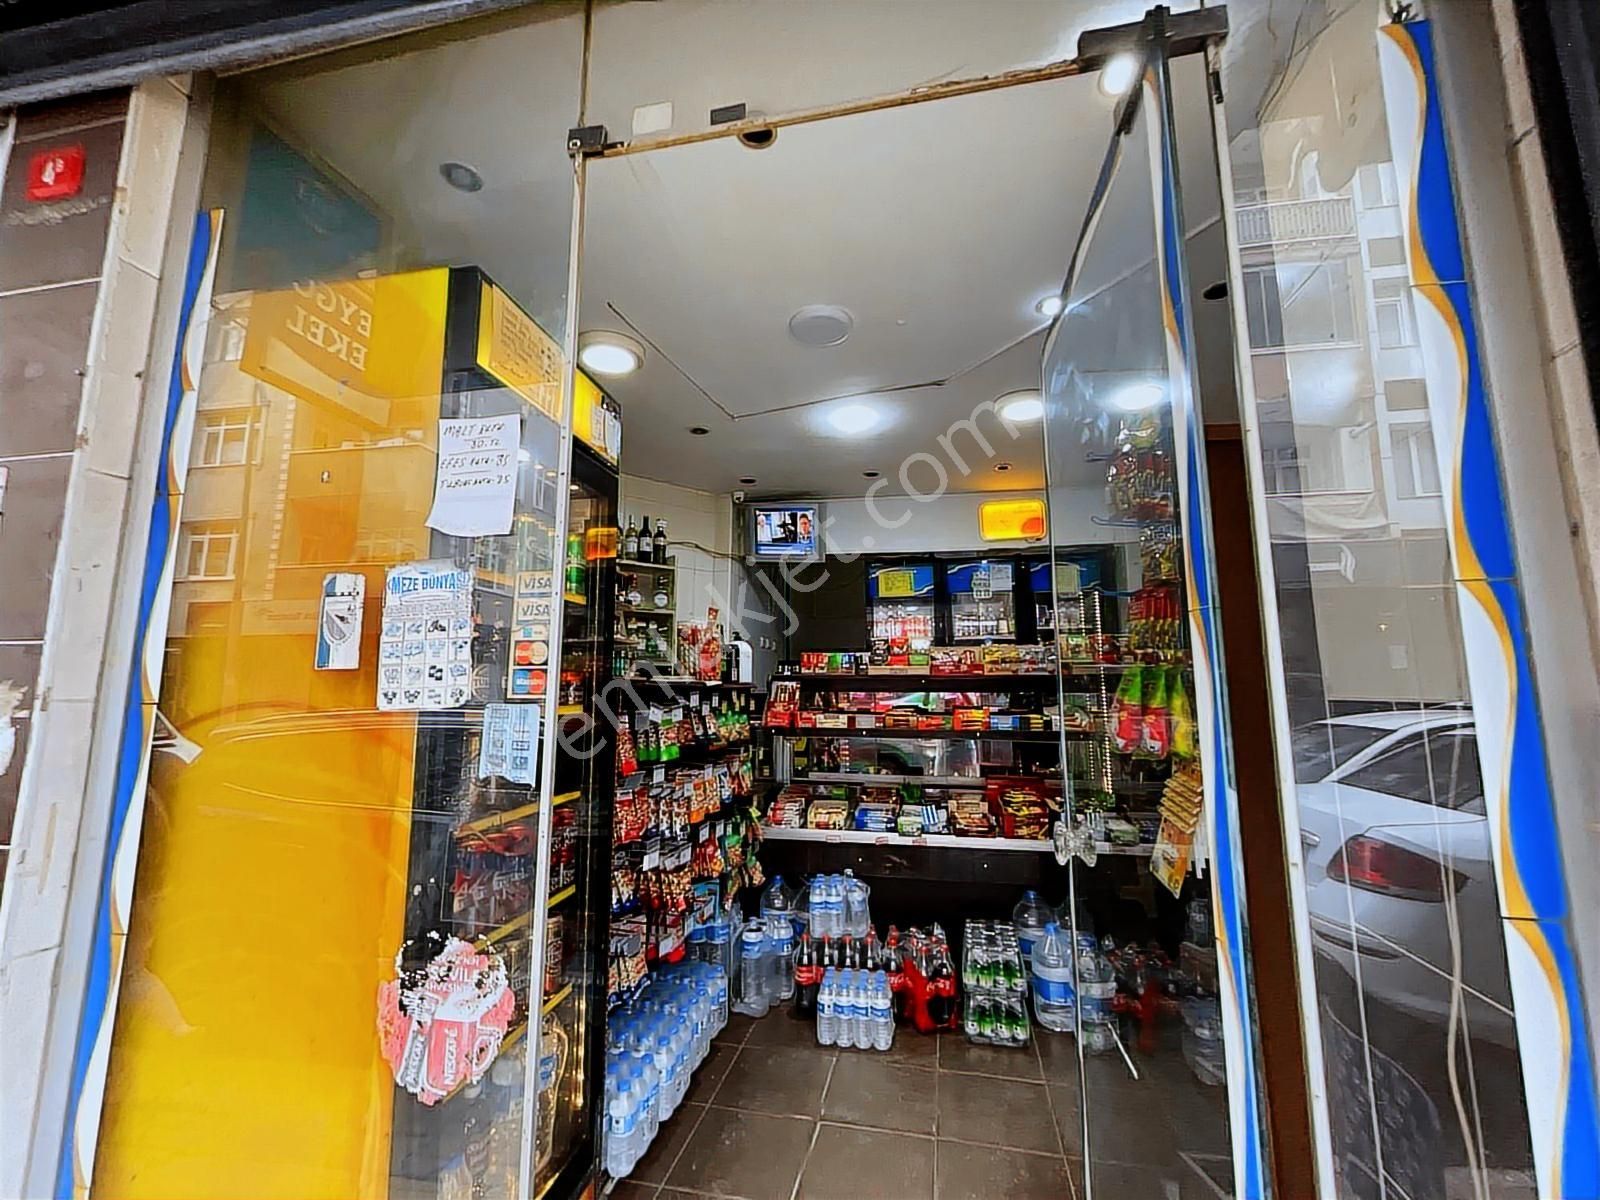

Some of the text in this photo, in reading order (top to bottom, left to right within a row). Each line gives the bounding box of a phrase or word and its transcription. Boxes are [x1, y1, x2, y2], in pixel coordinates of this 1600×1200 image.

[391, 576, 419, 594] MEZE
[523, 577, 552, 590] VISA
[521, 604, 550, 617] VISA
